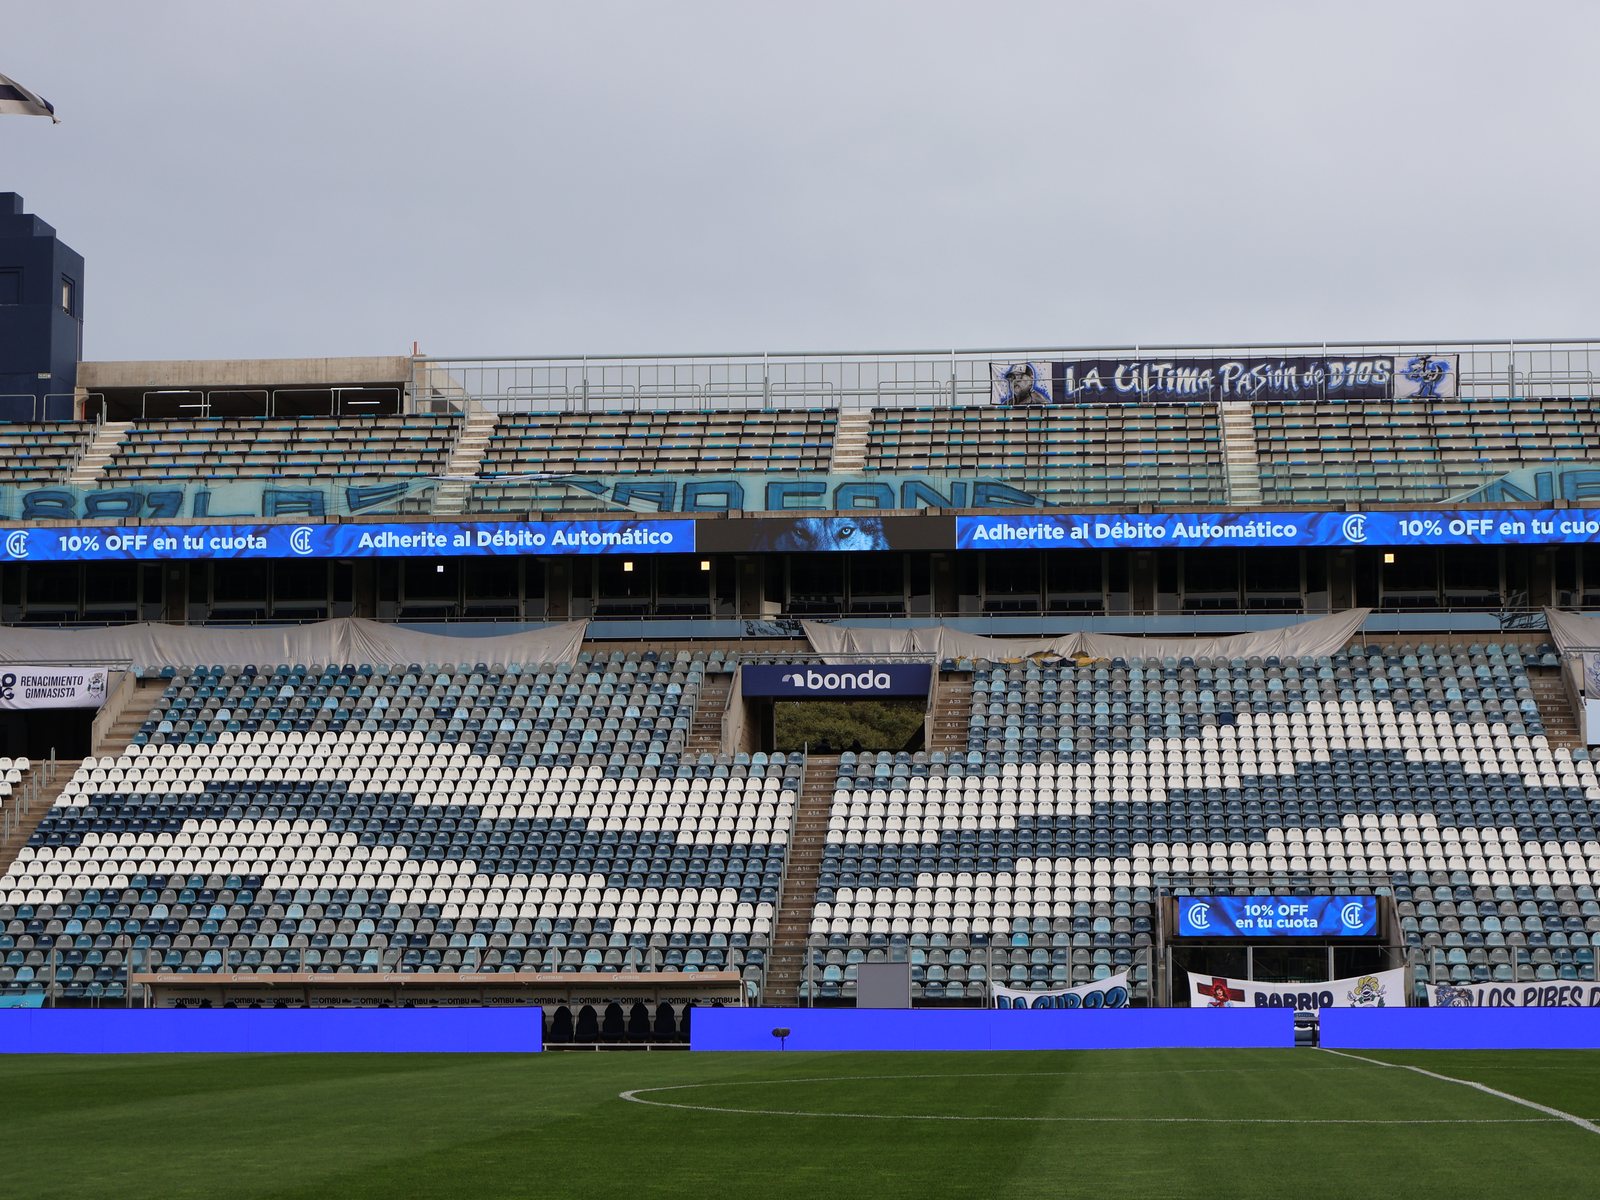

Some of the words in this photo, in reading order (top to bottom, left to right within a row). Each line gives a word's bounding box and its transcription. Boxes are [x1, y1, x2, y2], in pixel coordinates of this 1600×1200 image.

[1066, 366, 1104, 394] LA
[972, 523, 1065, 540] Adherite
[1070, 522, 1089, 540] al
[1095, 521, 1166, 539] Débito
[1171, 520, 1297, 539] Automático
[1399, 519, 1443, 536] 10%
[1448, 519, 1494, 536] OFF
[1499, 521, 1526, 535] en
[1531, 519, 1554, 535] tu
[1560, 520, 1600, 534] cuo
[59, 535, 100, 551] 10%
[105, 534, 148, 551] OFF
[152, 537, 177, 550] en
[182, 535, 204, 550] tu
[209, 534, 267, 550] cuota
[358, 531, 448, 548] Adherite
[452, 530, 471, 547] al
[477, 529, 546, 547] Débito
[551, 527, 673, 546] Automático
[20, 675, 84, 687] RENACIMIENTO
[807, 669, 891, 690] bonda
[25, 687, 76, 699] GIMNASISTA
[1244, 904, 1274, 916] 10%
[1278, 904, 1309, 916] OFF
[1235, 918, 1254, 929] en
[1256, 917, 1273, 928] tu
[1276, 917, 1318, 928] cuota
[1254, 991, 1334, 1011] BARRIO
[1478, 987, 1516, 1007] LOS
[1522, 985, 1584, 1007] PIBES
